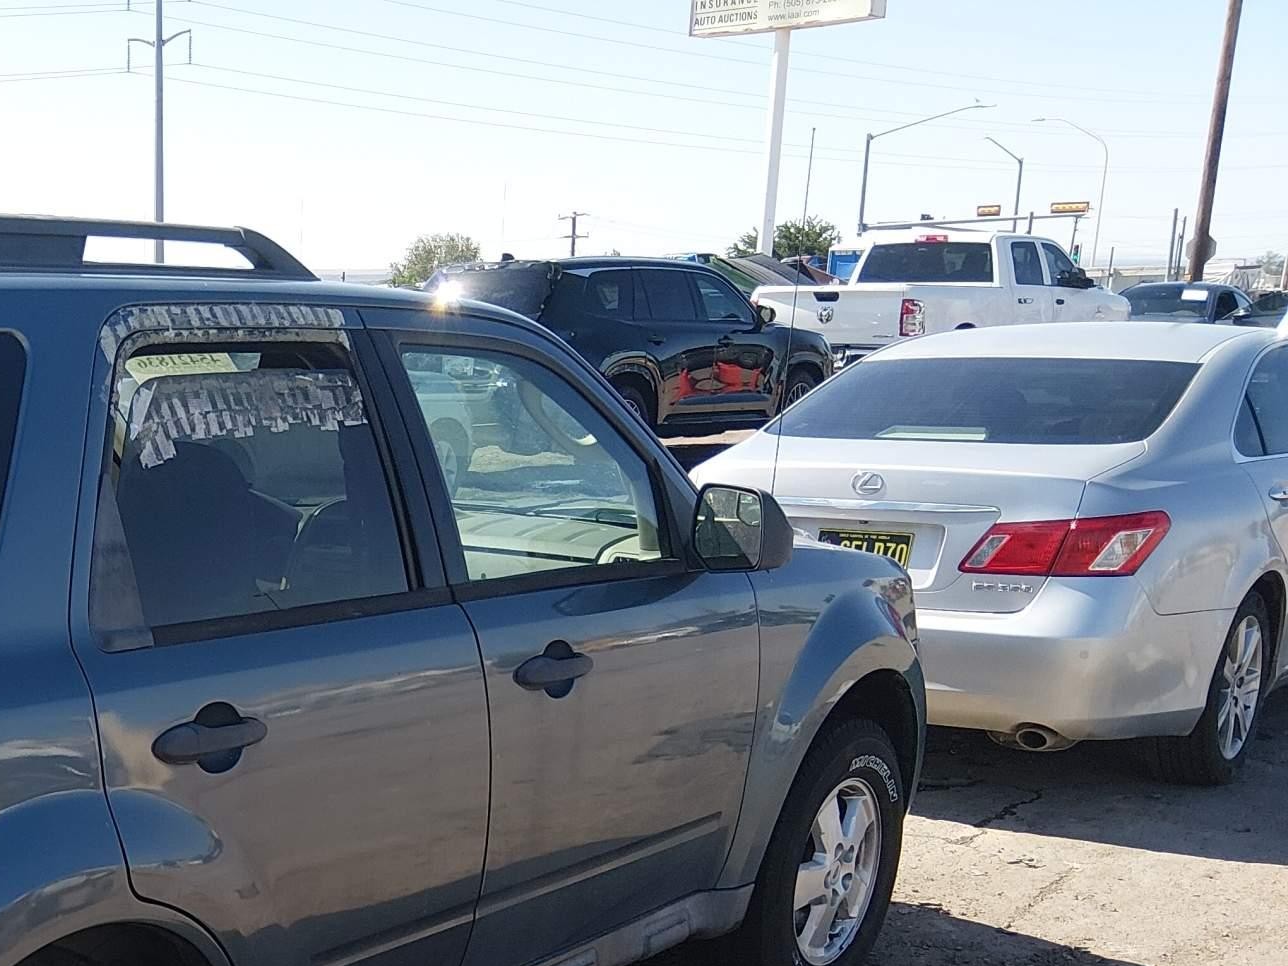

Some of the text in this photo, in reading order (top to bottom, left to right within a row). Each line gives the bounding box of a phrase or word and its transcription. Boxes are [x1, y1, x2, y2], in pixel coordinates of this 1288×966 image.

[694, 11, 758, 27] AUTO AUCTIONS
[848, 754, 899, 803] MICHELIN
